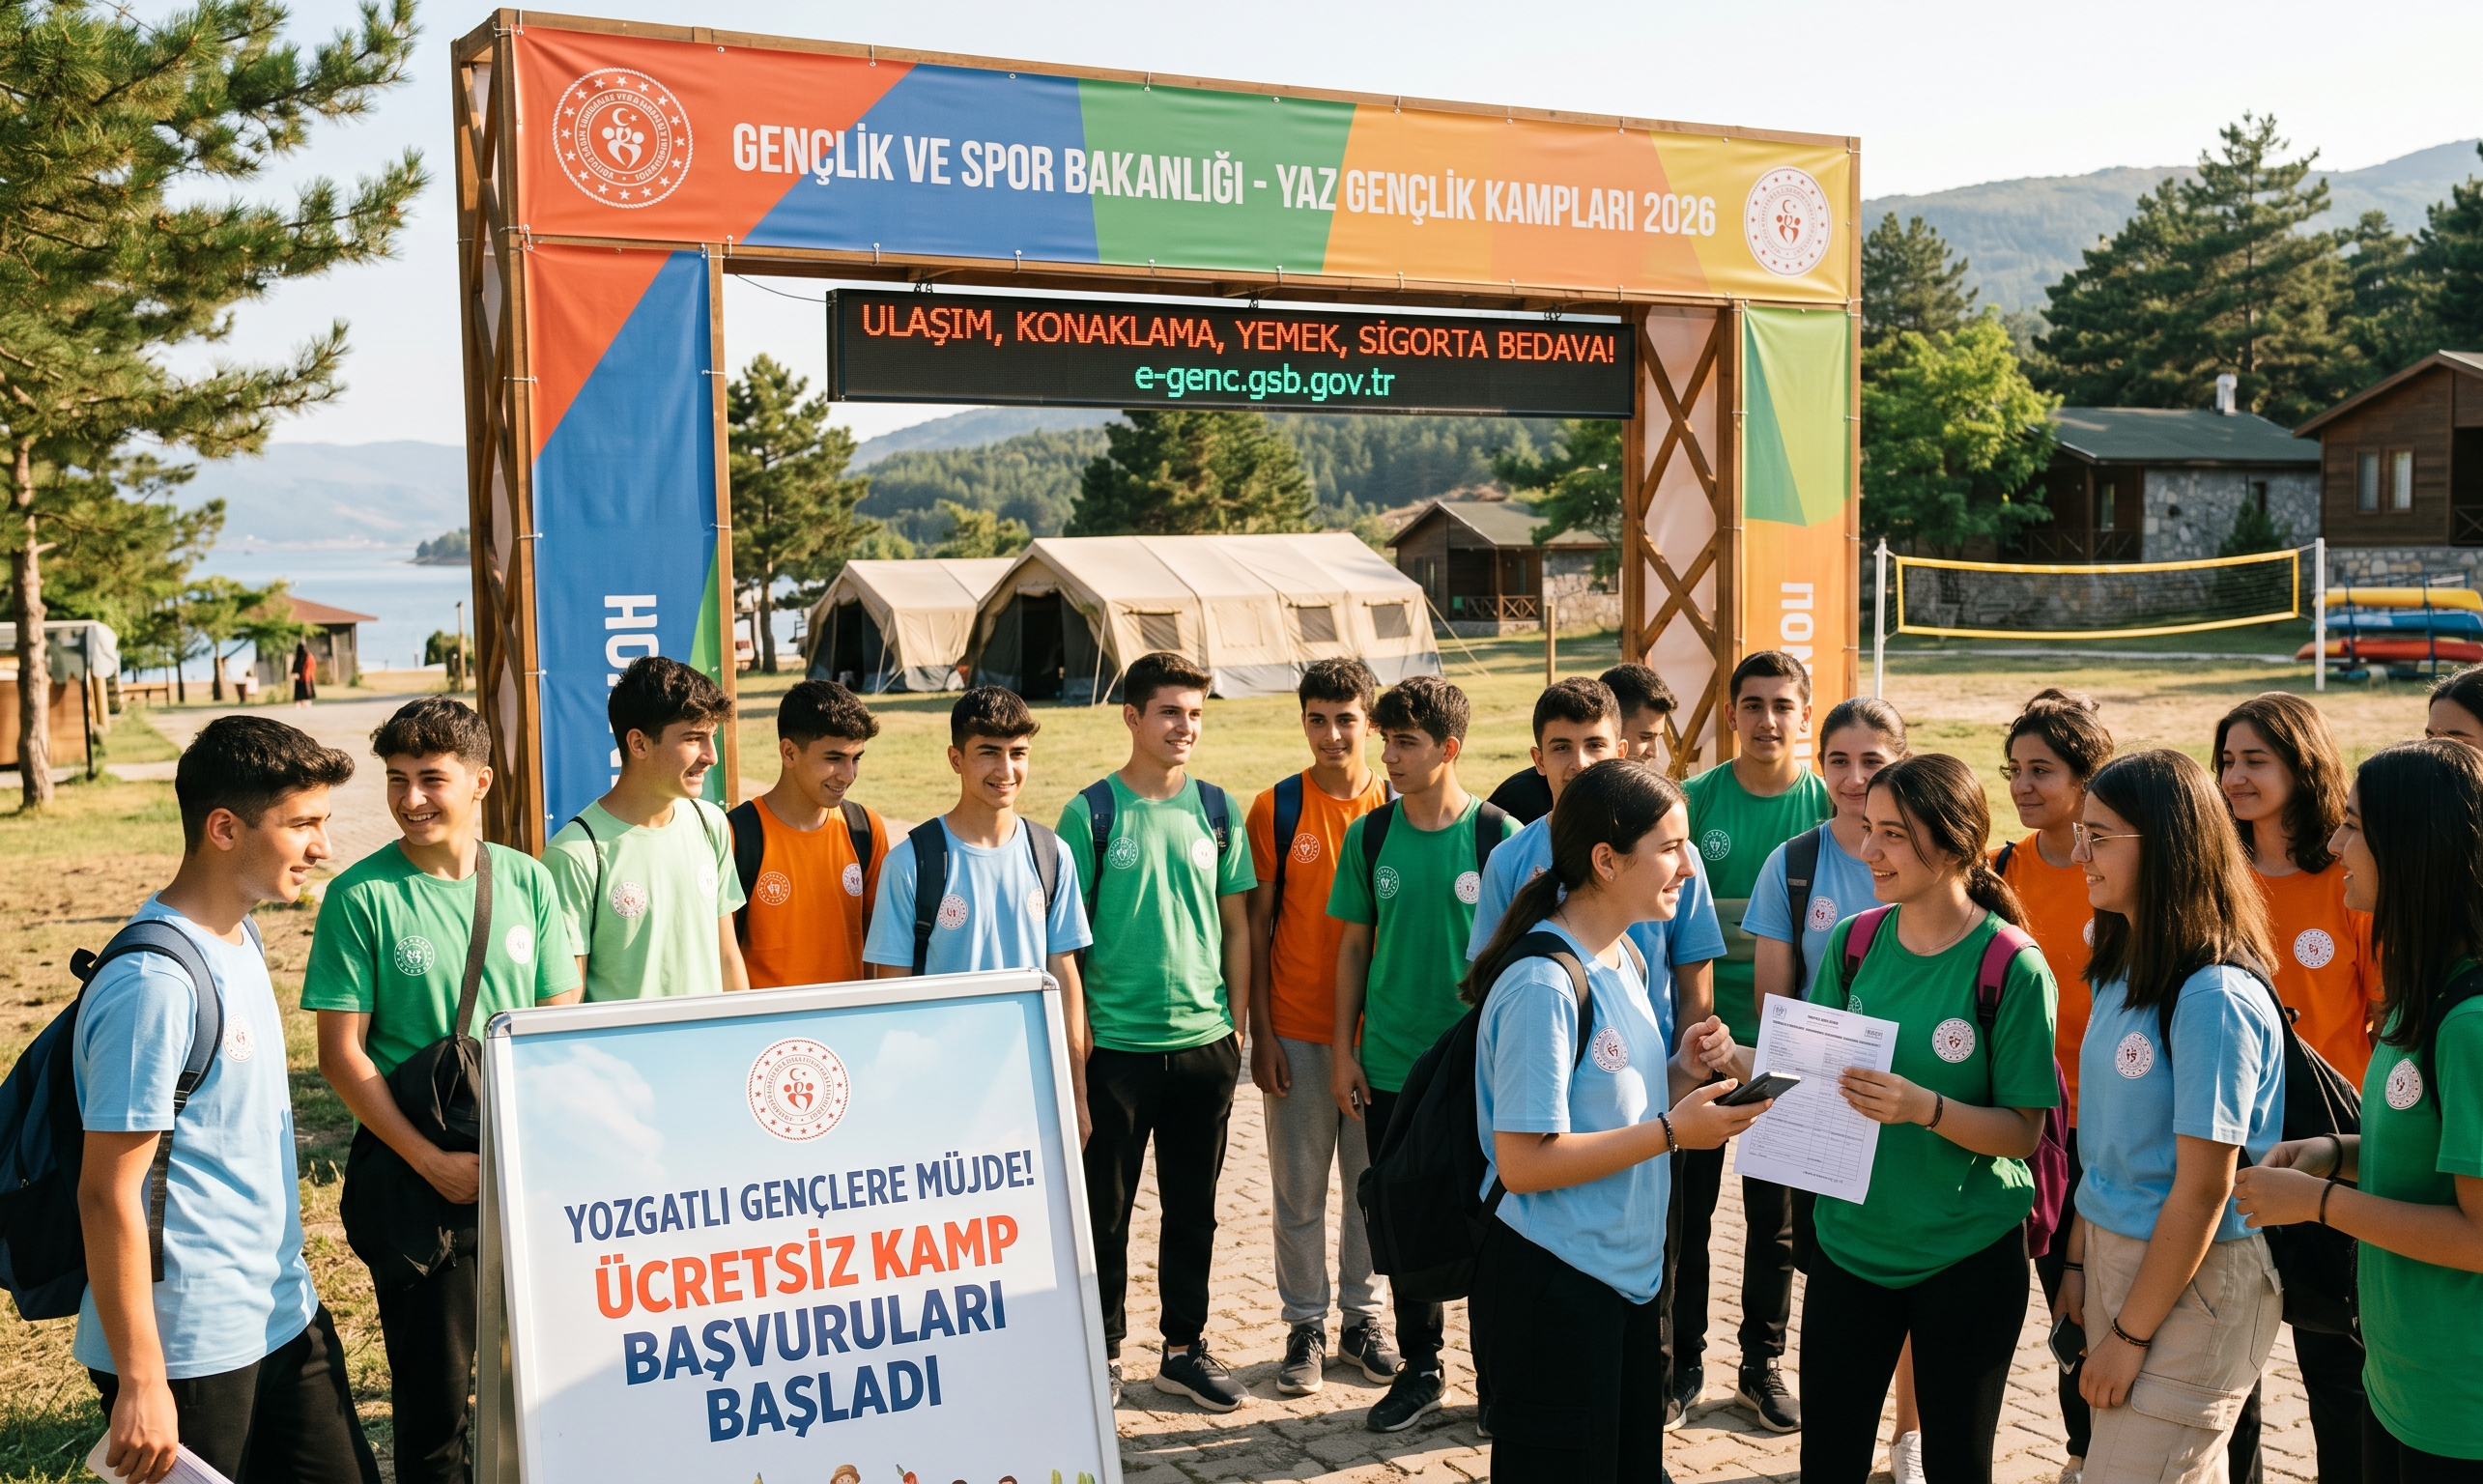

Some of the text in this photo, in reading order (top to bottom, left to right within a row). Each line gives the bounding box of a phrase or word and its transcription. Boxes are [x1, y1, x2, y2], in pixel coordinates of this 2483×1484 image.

[731, 122, 895, 185] GENÇLİK
[902, 134, 951, 185] VE
[962, 140, 1056, 192] SPOR
[1065, 150, 1243, 204] BAKANLIĞI
[1275, 164, 1338, 212] YAZ
[1345, 168, 1474, 226] GENÇLİK
[1484, 180, 1635, 232] KAMPLARI
[1643, 192, 1716, 237] 2026
[863, 303, 1615, 364] ULAŞIM, KONAKLAMA, YEMEK, SİGORTA BEDAVA!
[1134, 363, 1395, 401] e-genc.gsb.gov.tr
[564, 1150, 1035, 1243] YOZGATLI GENÇLERE MÜJDE!
[595, 1214, 1019, 1320] ÜCRETSİZ KAMP
[622, 1279, 1007, 1386] BAŞVURULARI
[705, 1355, 942, 1443] BAŞLADI
